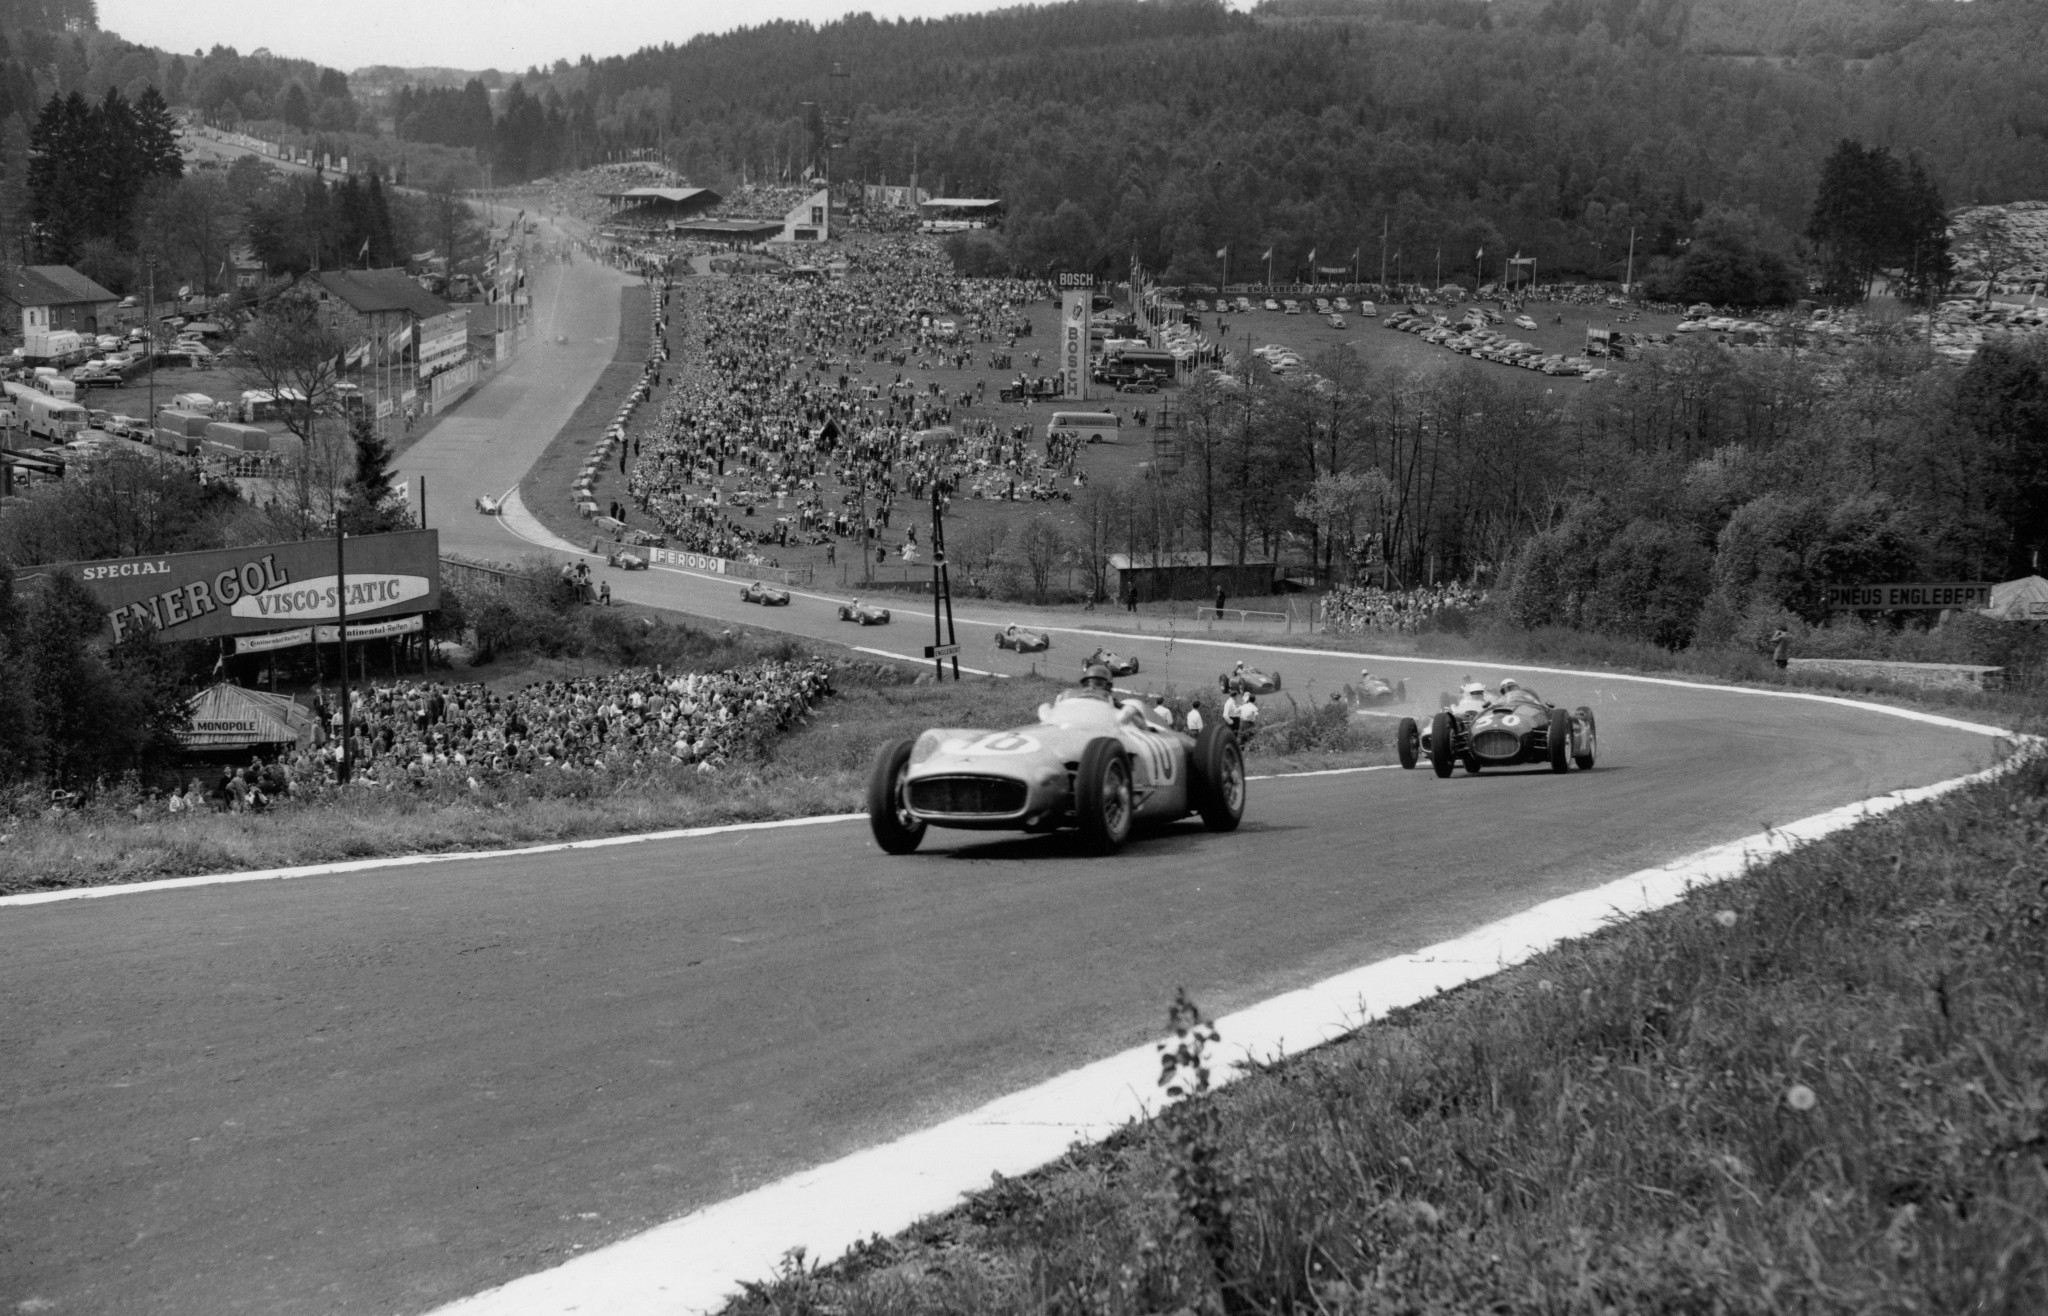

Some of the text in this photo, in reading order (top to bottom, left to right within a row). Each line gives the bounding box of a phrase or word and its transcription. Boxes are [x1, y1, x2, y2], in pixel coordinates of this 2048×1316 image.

[1060, 273, 1094, 286] BOSCH
[1066, 326, 1078, 396] BOSCH
[657, 549, 717, 571] FERODO
[83, 561, 171, 580] SPECIAL
[107, 554, 289, 645] ENERGOL
[1829, 587, 1987, 605] PNEUS ENGLEBERT
[338, 624, 408, 638] ntinental-Reifen
[935, 646, 961, 657] ENGLEBERT
[197, 721, 256, 731] MONOPOLE
[960, 731, 1029, 751] 10
